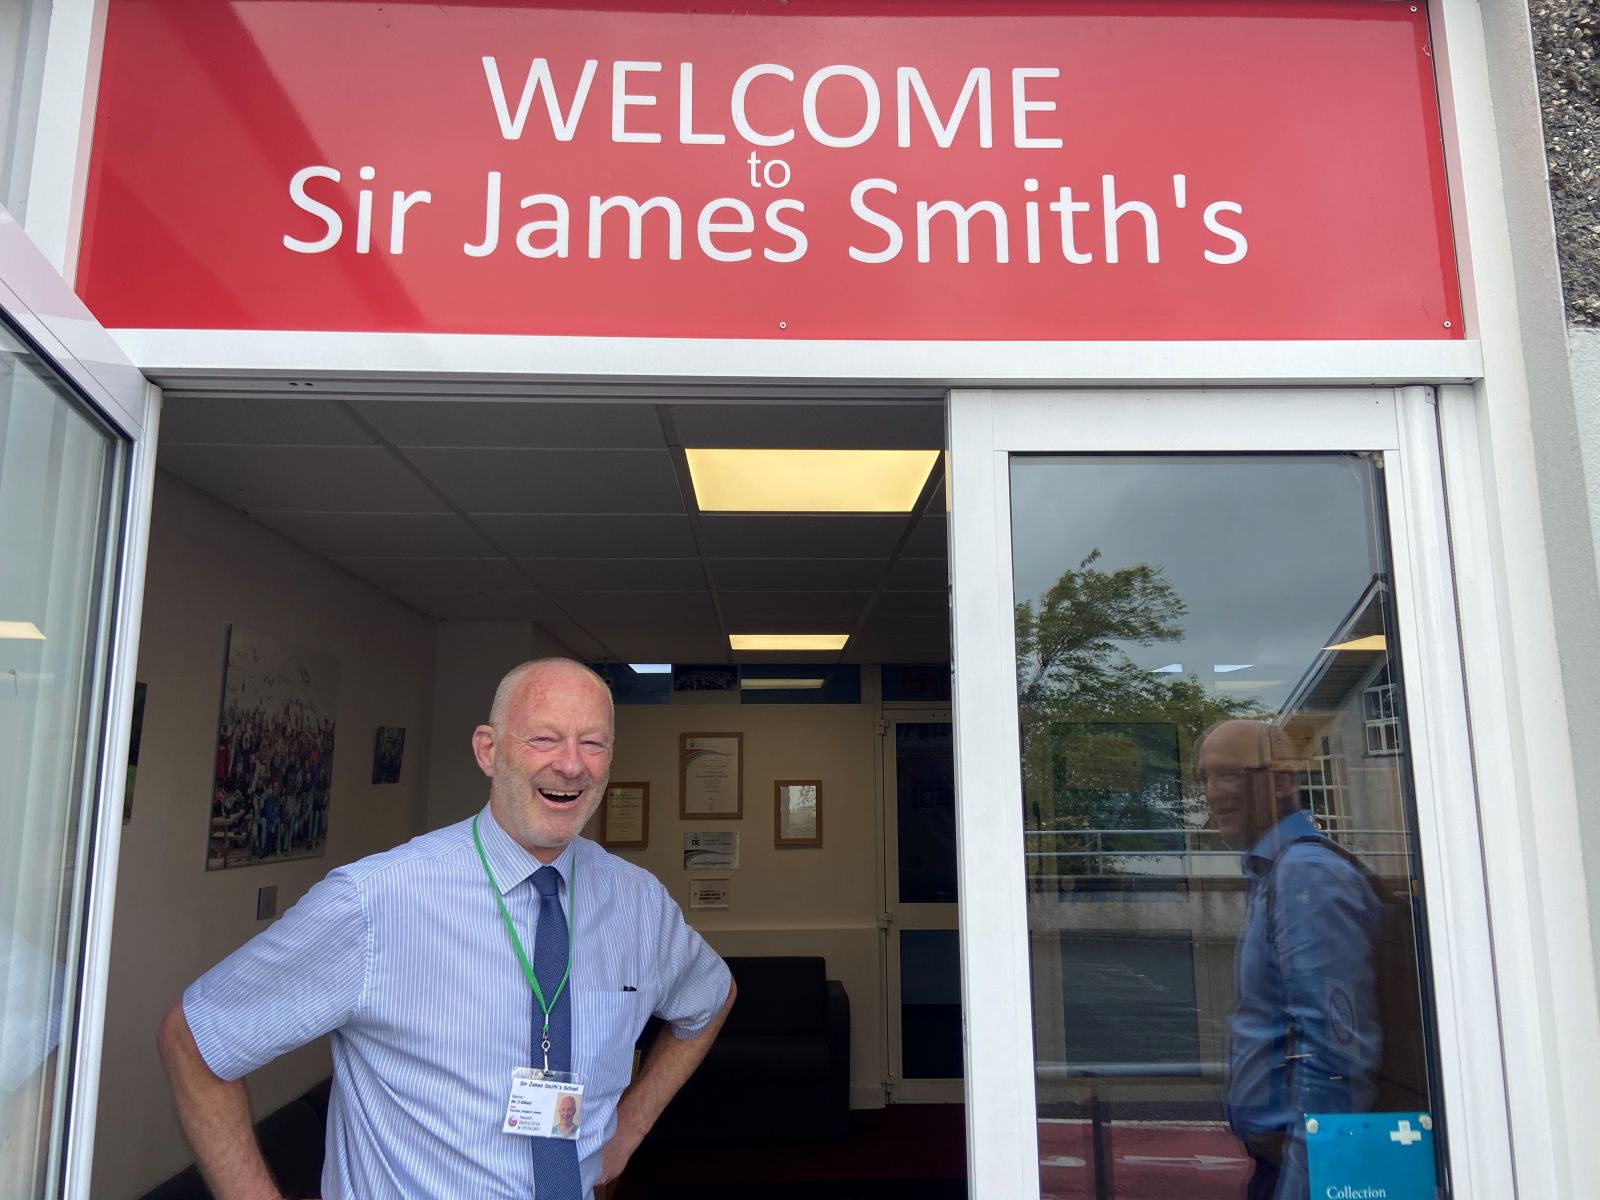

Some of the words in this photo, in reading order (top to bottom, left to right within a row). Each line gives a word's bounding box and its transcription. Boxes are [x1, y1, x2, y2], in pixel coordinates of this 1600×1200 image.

[482, 56, 1064, 149] WELCOME
[747, 150, 792, 190] to
[282, 165, 432, 255] Sir
[463, 170, 809, 264] James
[848, 173, 1249, 265] Smith's
[1326, 1185, 1387, 1199] Collection
